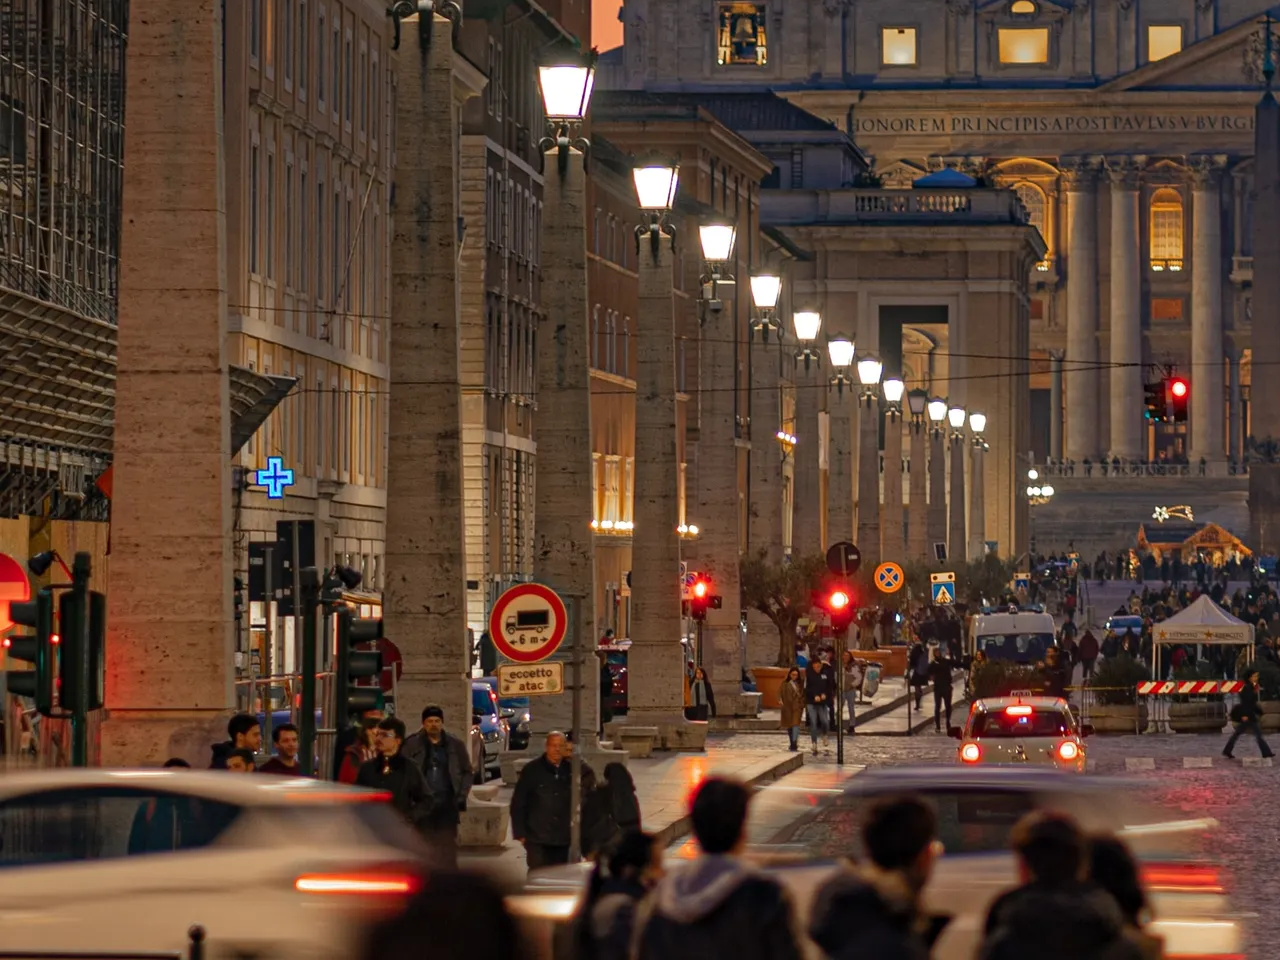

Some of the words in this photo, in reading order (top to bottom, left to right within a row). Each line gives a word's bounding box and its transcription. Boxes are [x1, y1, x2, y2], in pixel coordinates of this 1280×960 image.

[951, 116, 1048, 132] PRINCIPIS
[1112, 114, 1175, 130] PAVLVS
[519, 634, 526, 645] 6
[530, 635, 539, 644] m
[509, 668, 553, 679] eccetto
[518, 681, 545, 691] atac
